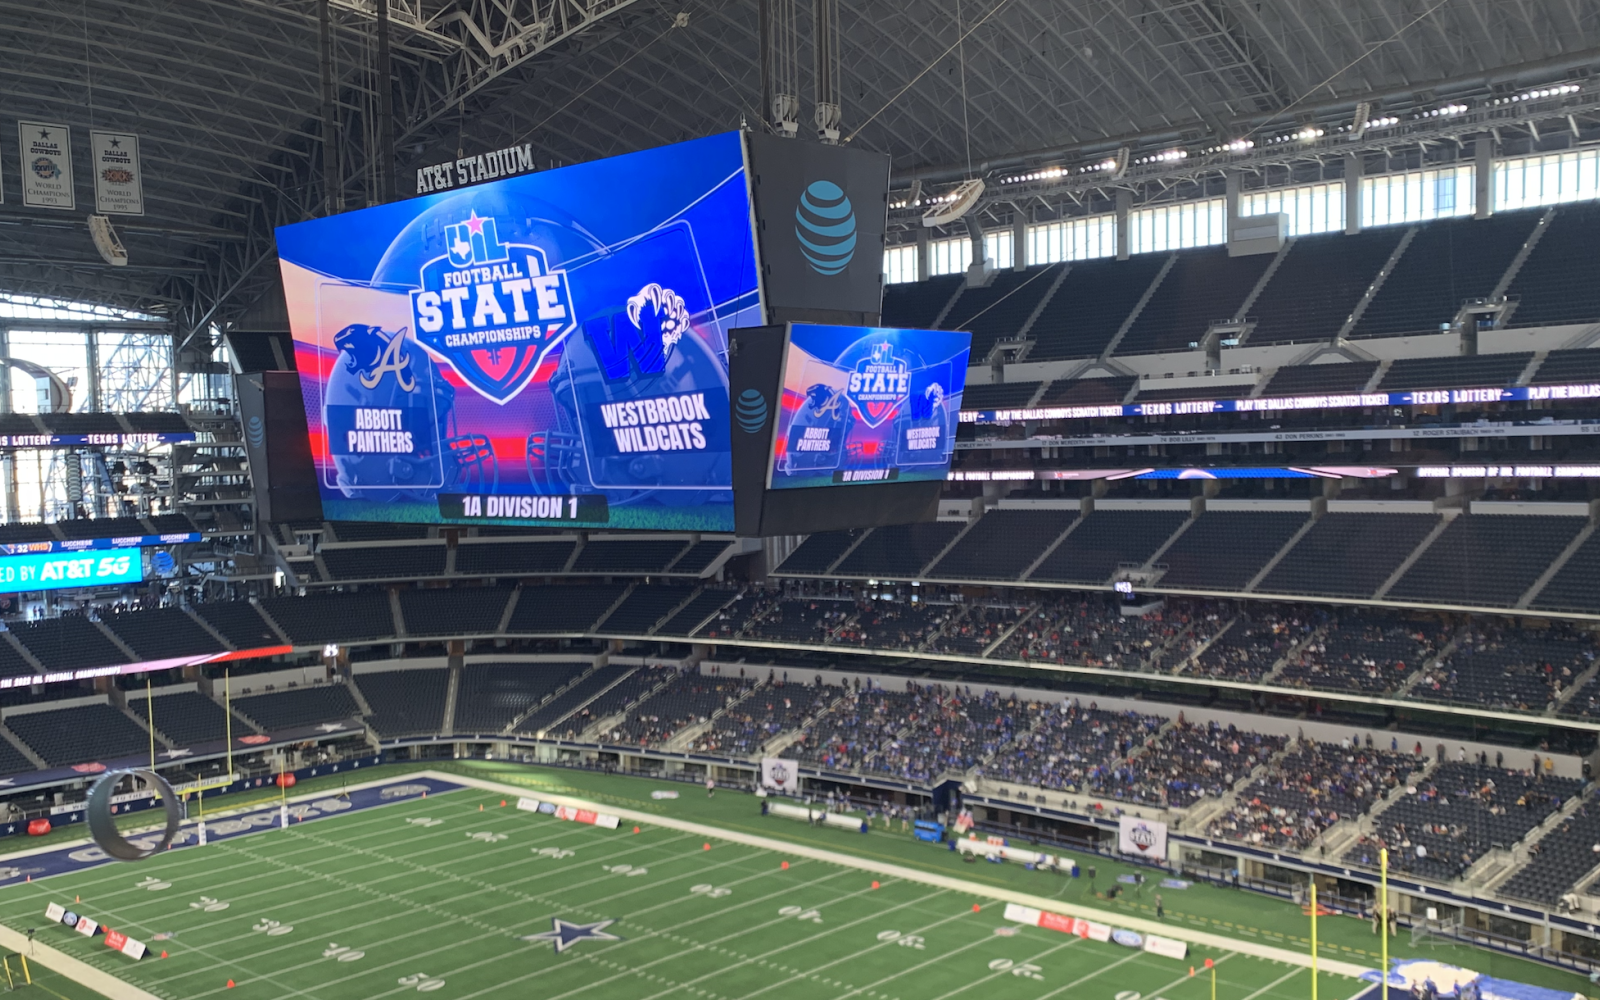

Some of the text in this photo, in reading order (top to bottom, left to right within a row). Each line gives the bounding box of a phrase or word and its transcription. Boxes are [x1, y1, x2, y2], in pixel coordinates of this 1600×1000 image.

[33, 141, 58, 149] DALLAS
[31, 148, 61, 156] COWBOYS
[417, 143, 535, 193] AT&T STADIUM
[35, 182, 61, 190] WORLD
[28, 189, 70, 198] CHAMPIONS
[100, 196, 139, 204] CHAMPIONS
[444, 262, 523, 288] FOOTBALL
[417, 274, 566, 332] STATE
[445, 325, 541, 347] CHAMPIONSHIPS
[865, 365, 897, 373] FOOTBALL
[850, 373, 908, 393] STATE
[1412, 388, 1502, 404] TEXAS LOTTERY
[1529, 384, 1600, 400] PLAY THE DALLAS
[1141, 401, 1215, 415] TEXAS LOTTERY
[1236, 400, 1253, 411] PLAY
[1253, 398, 1268, 410] THE
[1268, 397, 1294, 410] DALLAS
[1328, 394, 1360, 408] SCRATCH
[1361, 393, 1389, 406] TICKET!
[601, 393, 710, 428] WESTBROOK
[958, 411, 979, 422] TERY
[996, 410, 1010, 421] PLAY
[1010, 408, 1022, 420] THE
[1022, 408, 1044, 420] DALLAS
[1072, 406, 1099, 418] SCRATCH
[356, 408, 402, 430] ABBOTT
[88, 433, 159, 444] TEXAS LOTTERY
[613, 422, 706, 453] WILDCATS
[804, 427, 830, 440] ABBOTT
[906, 427, 940, 440] WESTBROOK
[1446, 428, 1478, 436] STAUBACH
[12, 434, 52, 446] LOTTERY
[348, 431, 414, 453] PANTHERS
[797, 439, 831, 451] PANTHERS
[908, 438, 936, 450] WILDCATS
[852, 470, 884, 481] DIVISION
[965, 471, 990, 480] FOOTBALL
[1418, 467, 1450, 477] OFFICIAL
[1515, 466, 1553, 477] FOOTBALL
[462, 496, 578, 519] 1A DIVISION 1
[17, 545, 28, 553] 32
[20, 565, 36, 581] BY
[40, 559, 95, 581] AT&T
[96, 556, 130, 577] 5G
[44, 671, 74, 683] FOOTBALL
